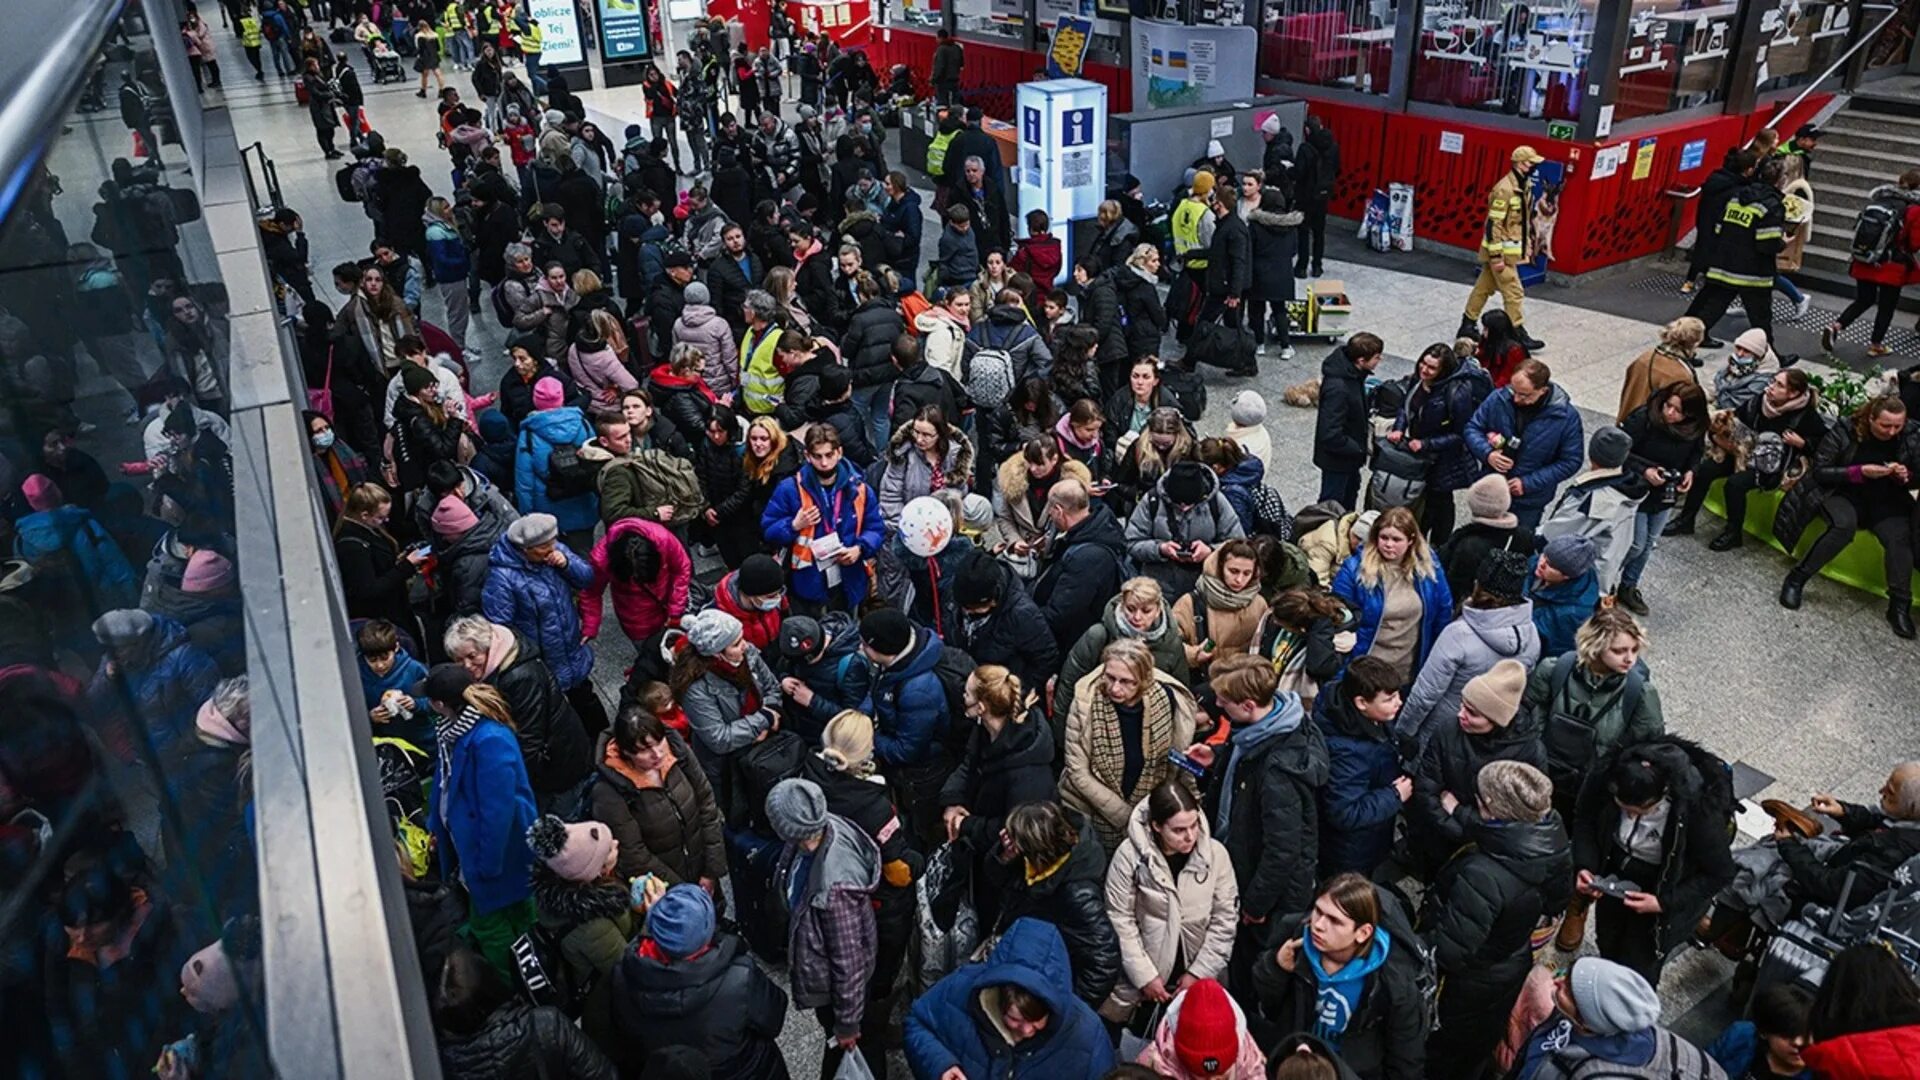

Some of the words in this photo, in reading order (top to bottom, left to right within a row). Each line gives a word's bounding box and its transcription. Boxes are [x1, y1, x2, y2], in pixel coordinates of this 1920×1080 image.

[534, 6, 572, 18] oblicze
[547, 22, 564, 34] Tej
[542, 39, 575, 51] Ziemi!
[1071, 111, 1084, 144] i
